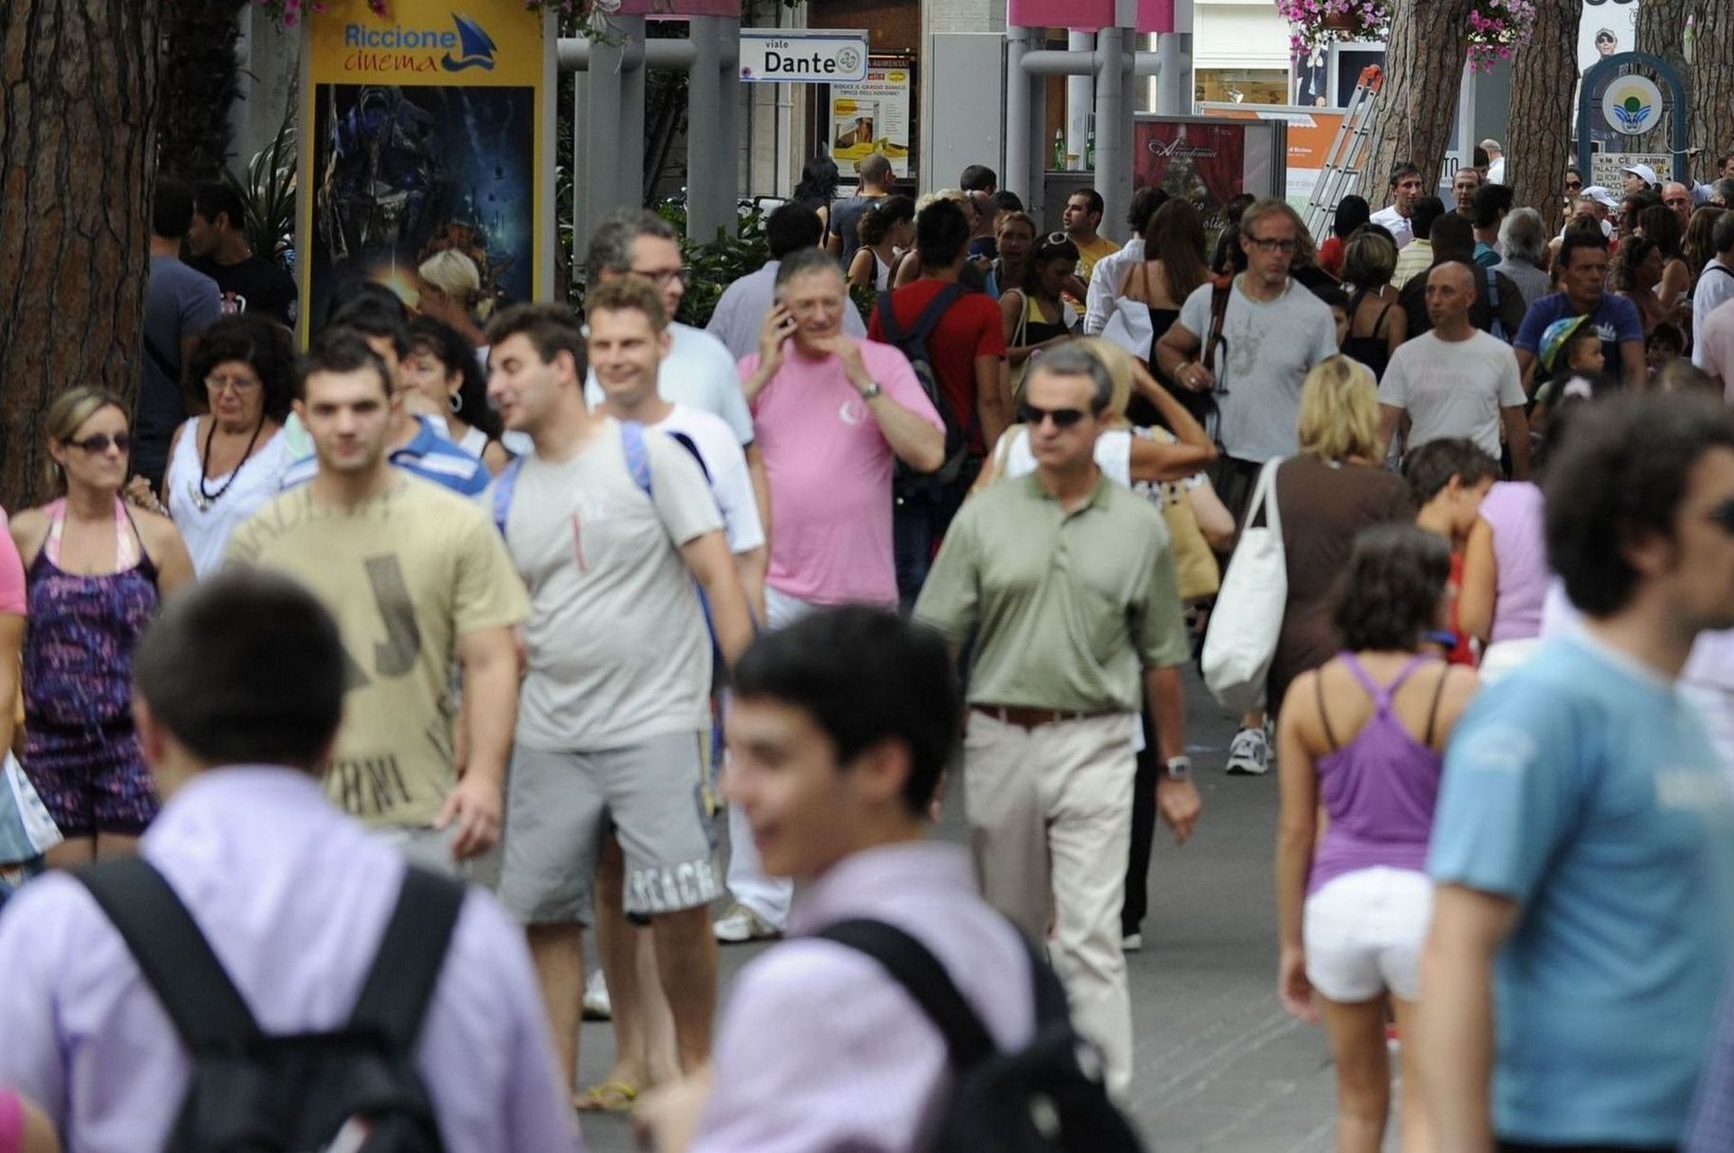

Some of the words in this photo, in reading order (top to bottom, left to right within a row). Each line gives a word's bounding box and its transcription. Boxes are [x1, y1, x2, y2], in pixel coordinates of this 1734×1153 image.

[344, 24, 456, 49] Riccione
[765, 40, 789, 49] viale
[344, 50, 438, 72] cinema
[765, 51, 836, 74] Dante
